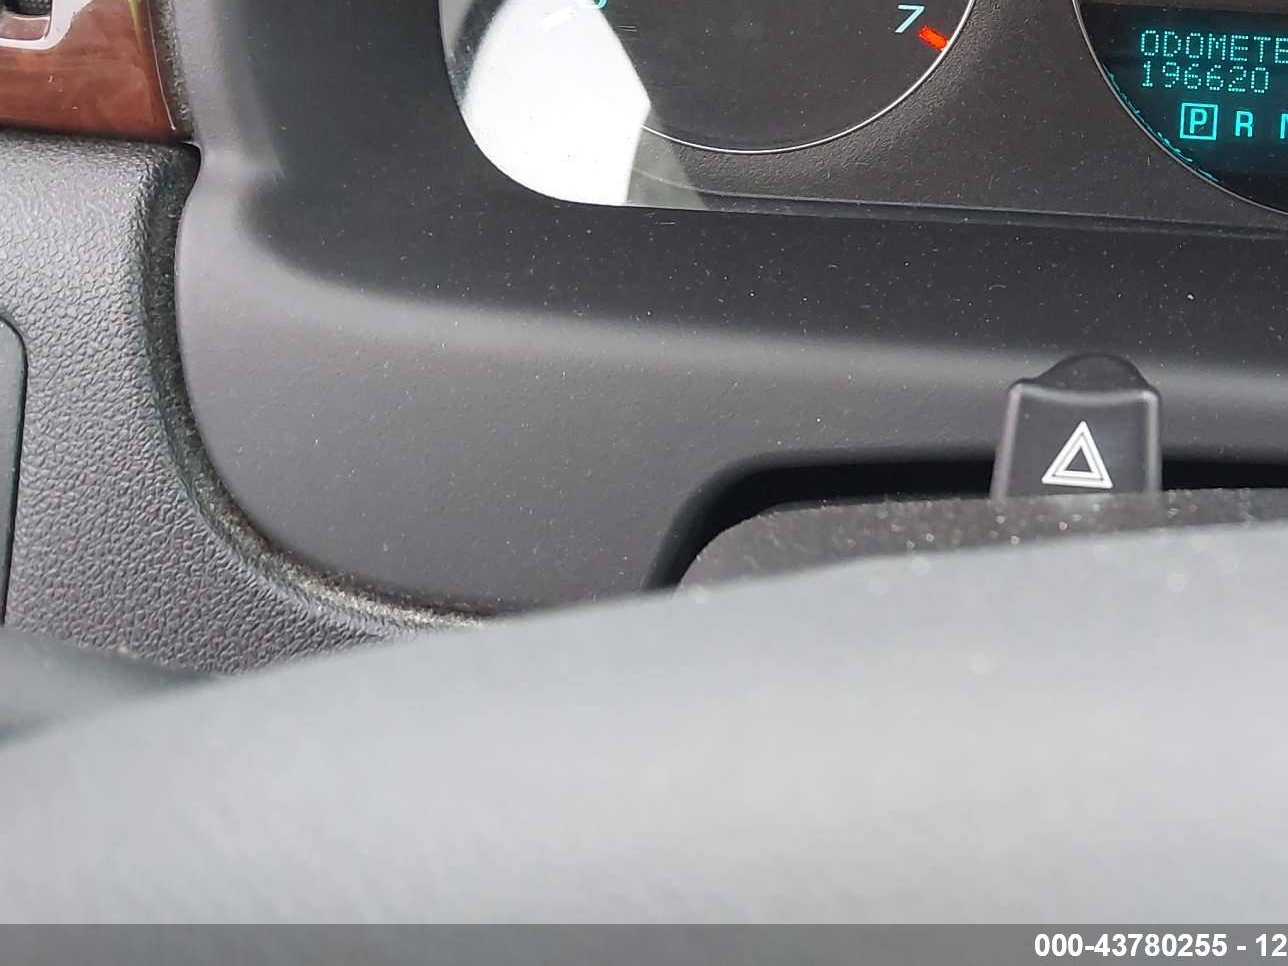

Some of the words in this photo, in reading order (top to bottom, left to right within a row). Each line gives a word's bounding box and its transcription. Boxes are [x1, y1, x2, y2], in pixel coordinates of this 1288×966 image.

[894, 4, 925, 34] 7
[1140, 60, 1270, 94] 196620
[1188, 108, 1207, 134] P
[1234, 112, 1255, 138] R
